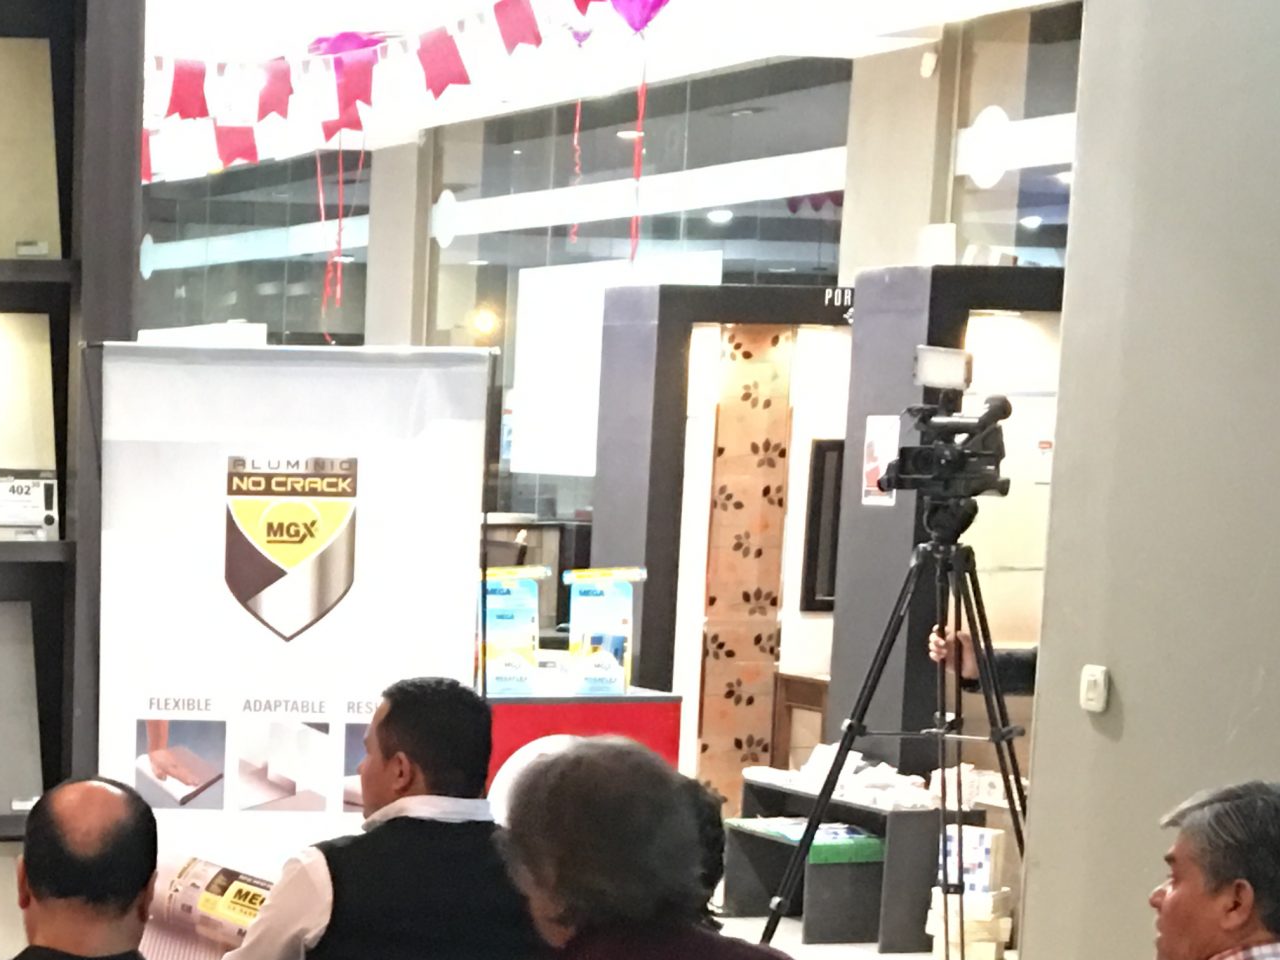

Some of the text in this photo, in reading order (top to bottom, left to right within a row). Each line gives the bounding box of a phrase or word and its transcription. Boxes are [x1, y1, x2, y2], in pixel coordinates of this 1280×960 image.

[232, 459, 353, 471] ALUMINIO
[9, 485, 31, 495] 402
[232, 476, 353, 492] NO CRACK
[266, 519, 318, 543] MGX
[149, 697, 212, 712] FLEXIBLE
[242, 699, 326, 713] ADAPTABLE
